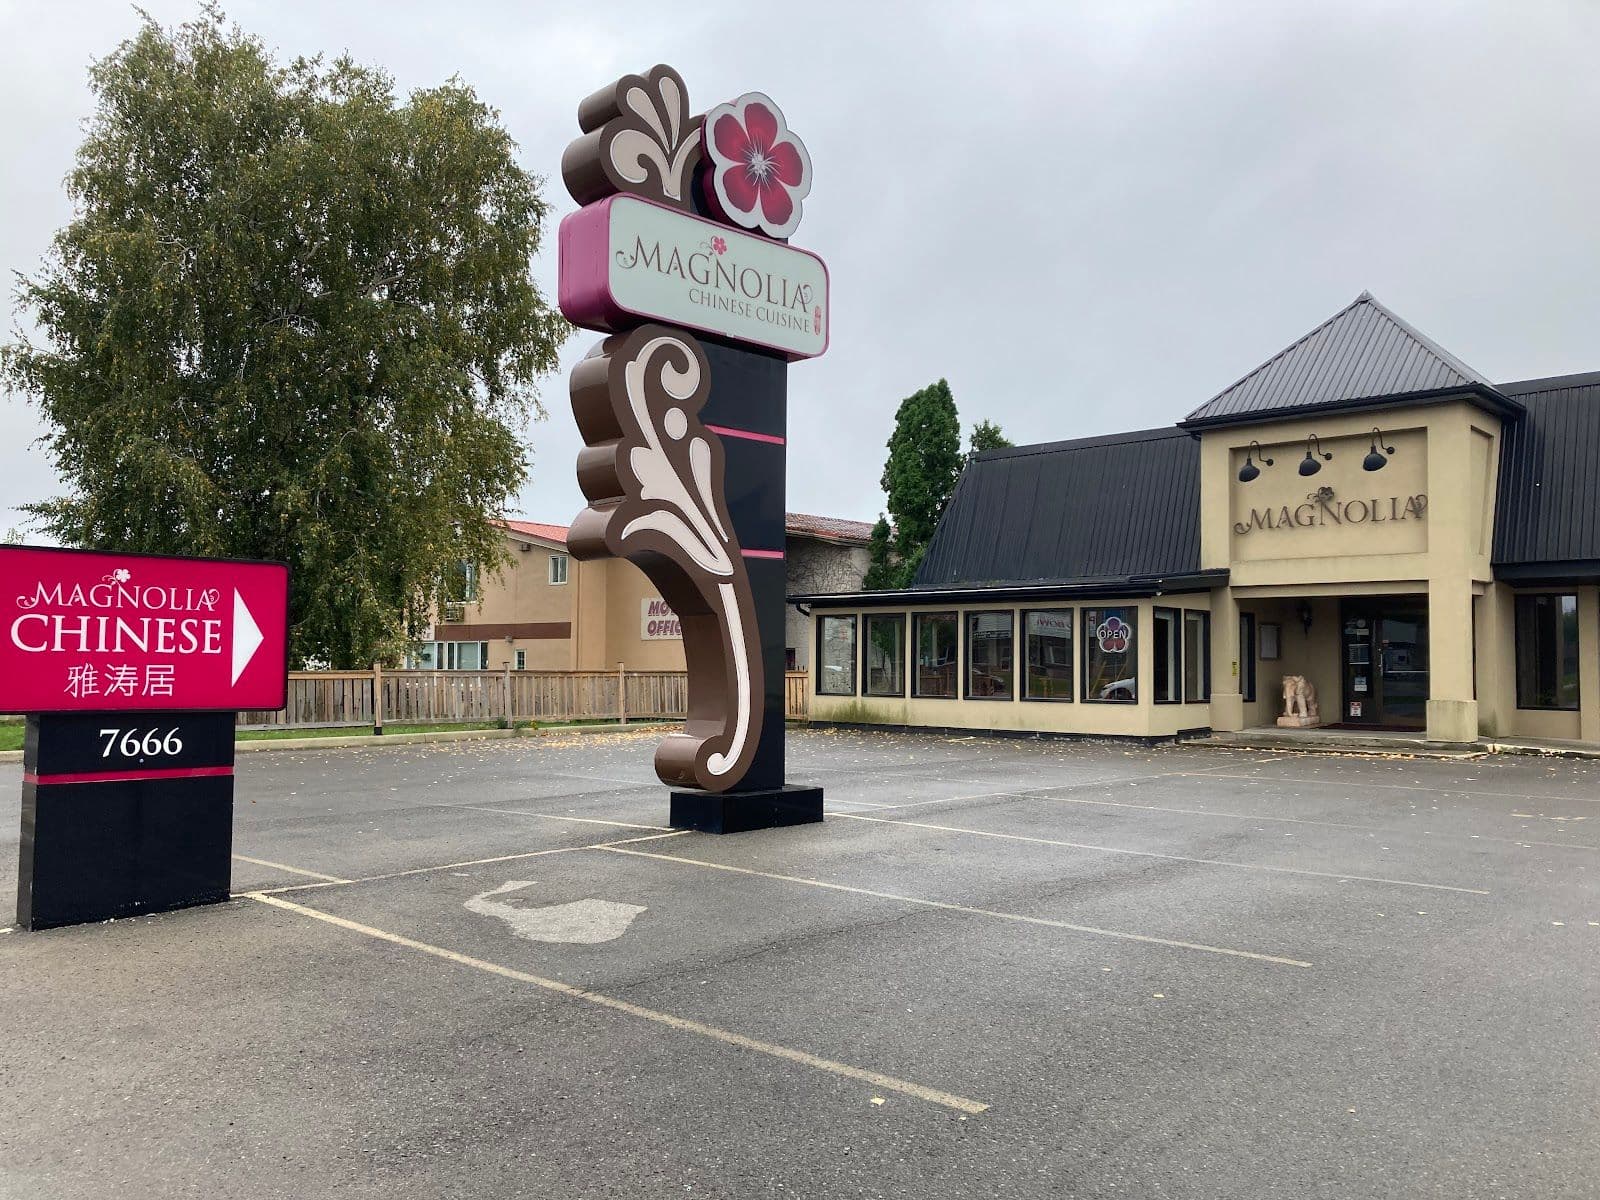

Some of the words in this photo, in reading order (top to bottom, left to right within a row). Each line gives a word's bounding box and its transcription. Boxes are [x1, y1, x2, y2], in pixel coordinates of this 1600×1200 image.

[616, 236, 812, 312] MAGNOLIA
[689, 288, 752, 318] CHINESE
[756, 306, 810, 333] CUISINE
[1234, 494, 1428, 535] MAGNOLIA
[16, 581, 220, 611] MAGNOLIA
[647, 600, 675, 616] MO
[11, 614, 222, 655] CHINESE
[1098, 629, 1127, 640] OPEN
[64, 662, 175, 698] 雅涛居
[99, 726, 183, 758] 7666
